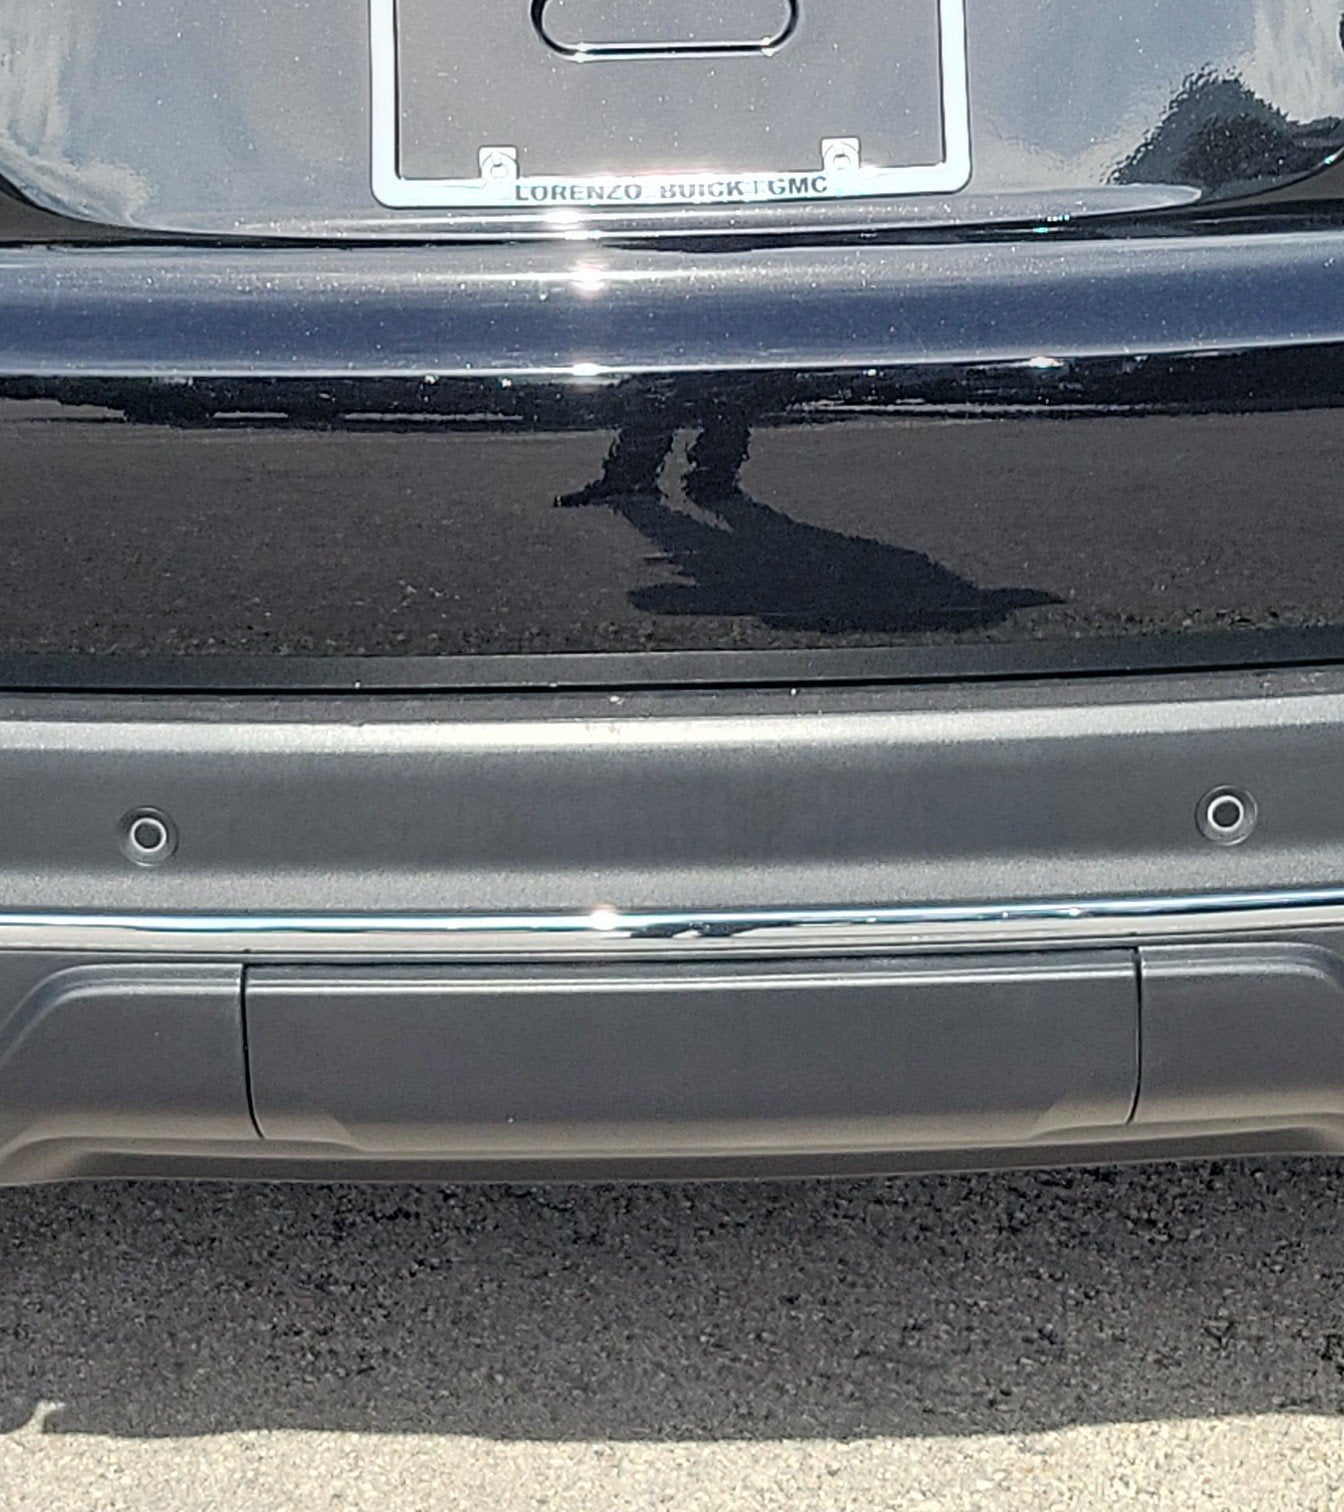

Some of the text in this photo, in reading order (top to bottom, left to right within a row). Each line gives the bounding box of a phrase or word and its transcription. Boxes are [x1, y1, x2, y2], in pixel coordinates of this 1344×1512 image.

[515, 175, 828, 202] LORENZO BUICK GMC
